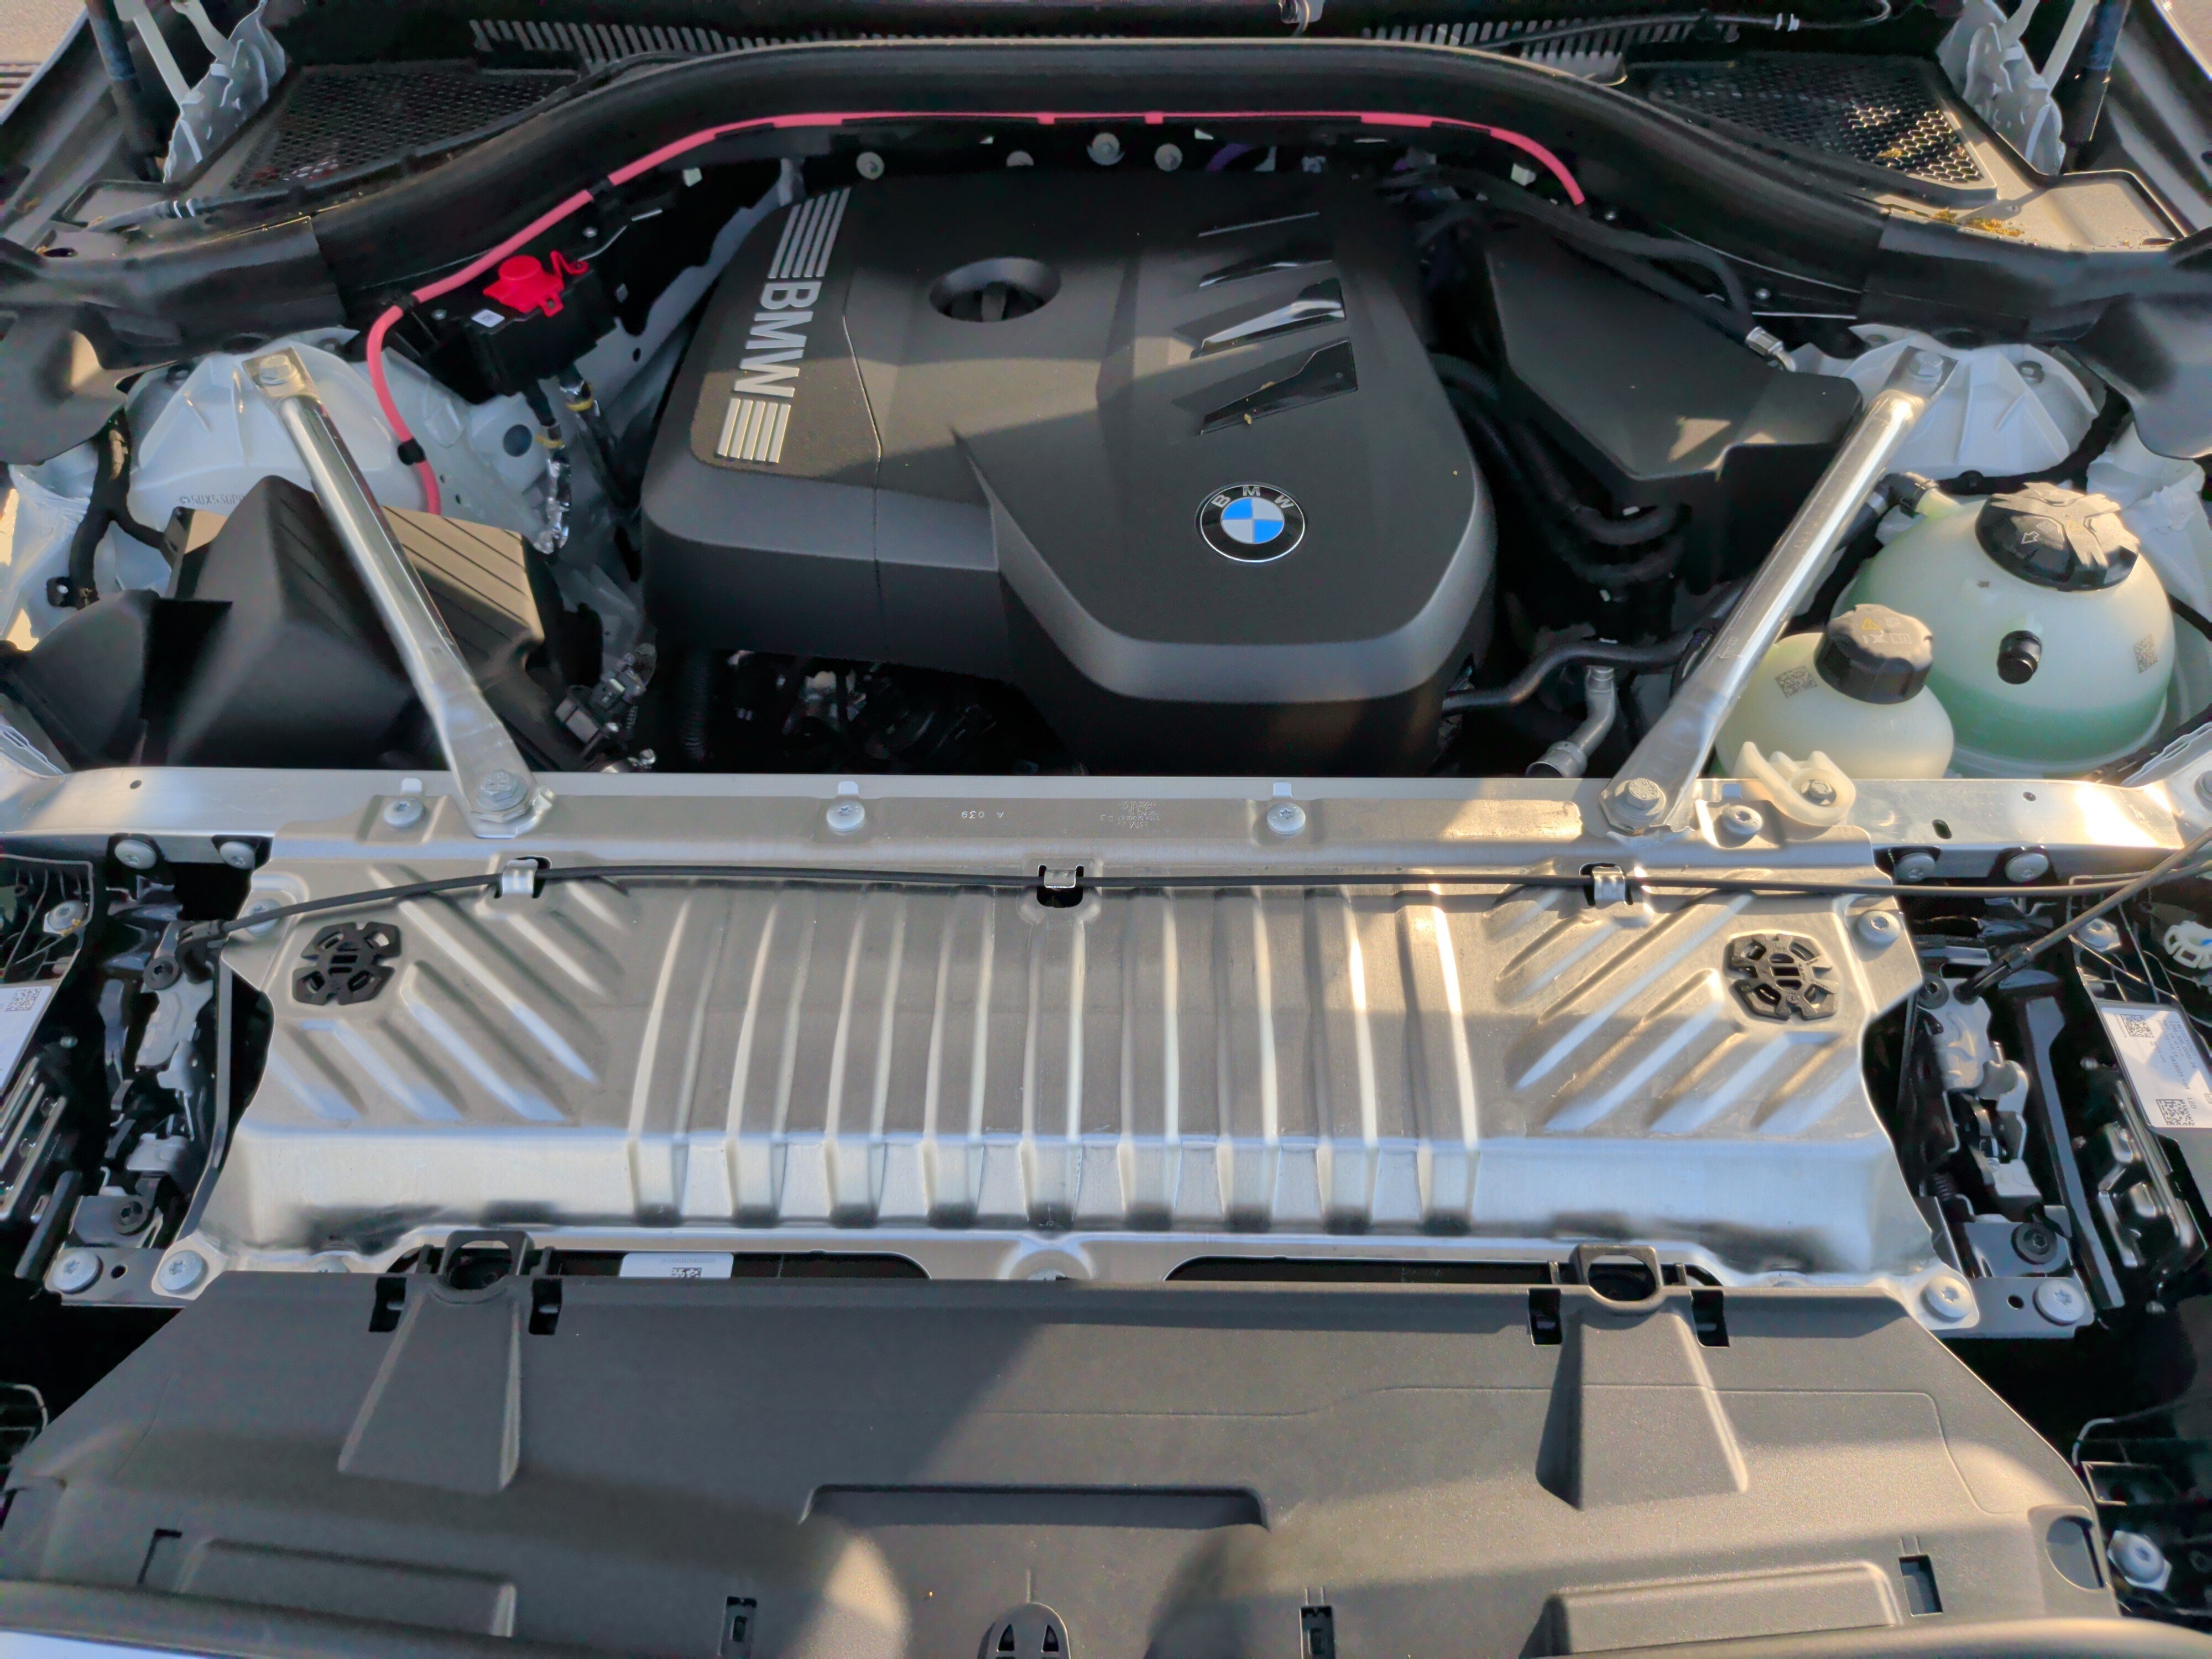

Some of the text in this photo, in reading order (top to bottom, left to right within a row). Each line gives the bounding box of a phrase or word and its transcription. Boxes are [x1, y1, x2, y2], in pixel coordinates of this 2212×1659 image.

[734, 281, 822, 398] BMW
[1211, 486, 1295, 509] BMW
[2188, 1098, 2197, 1109] LED
